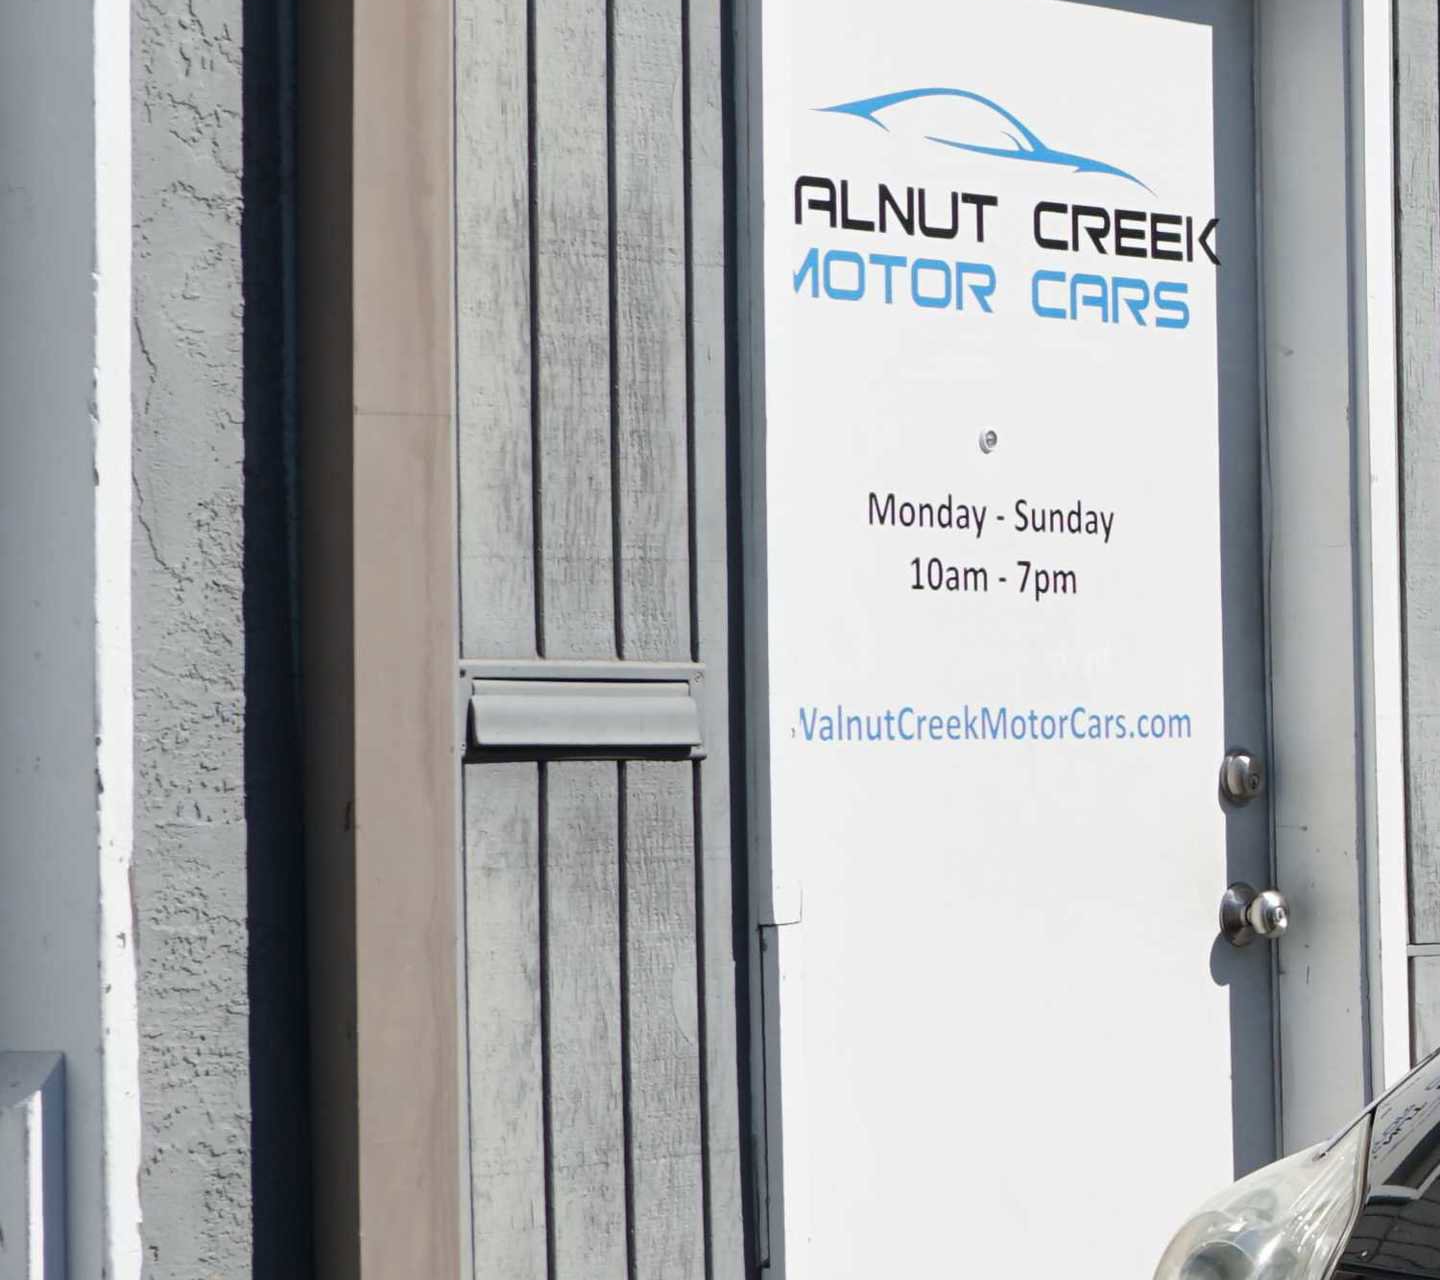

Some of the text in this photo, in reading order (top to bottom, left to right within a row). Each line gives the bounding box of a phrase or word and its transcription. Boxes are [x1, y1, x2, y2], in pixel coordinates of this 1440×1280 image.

[794, 175, 1222, 266] ALNUT CREEK
[1031, 269, 1191, 330] CARS
[868, 491, 988, 539] Monday
[1014, 498, 1115, 544] Sunday
[909, 556, 989, 592] 10am
[1017, 560, 1078, 602] 7pm
